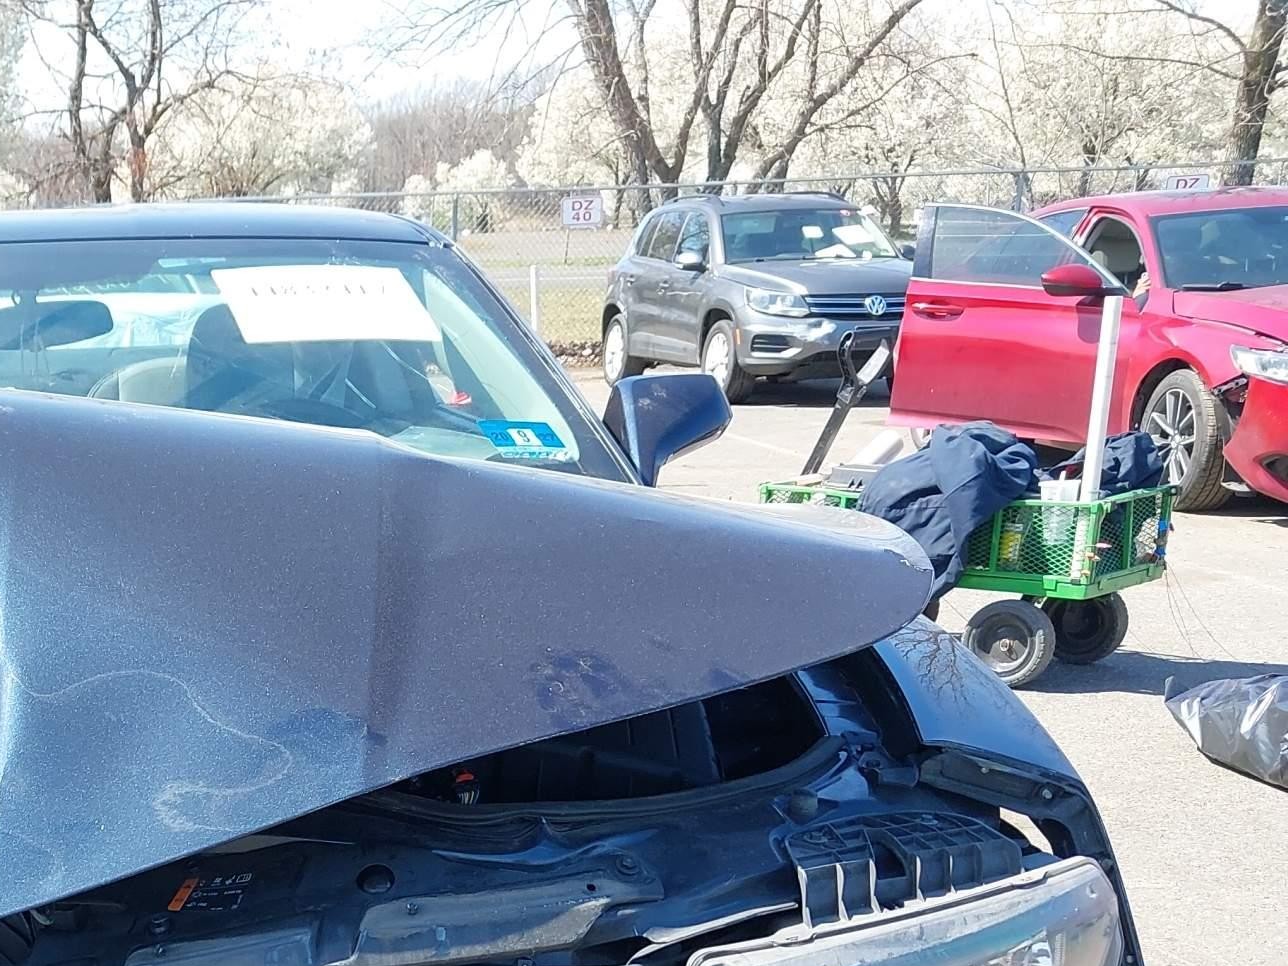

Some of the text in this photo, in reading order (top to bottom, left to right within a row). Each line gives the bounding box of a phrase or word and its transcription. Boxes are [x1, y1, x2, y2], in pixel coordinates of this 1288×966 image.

[572, 200, 594, 211] DZ
[572, 211, 592, 222] 40
[517, 430, 531, 443] 9
